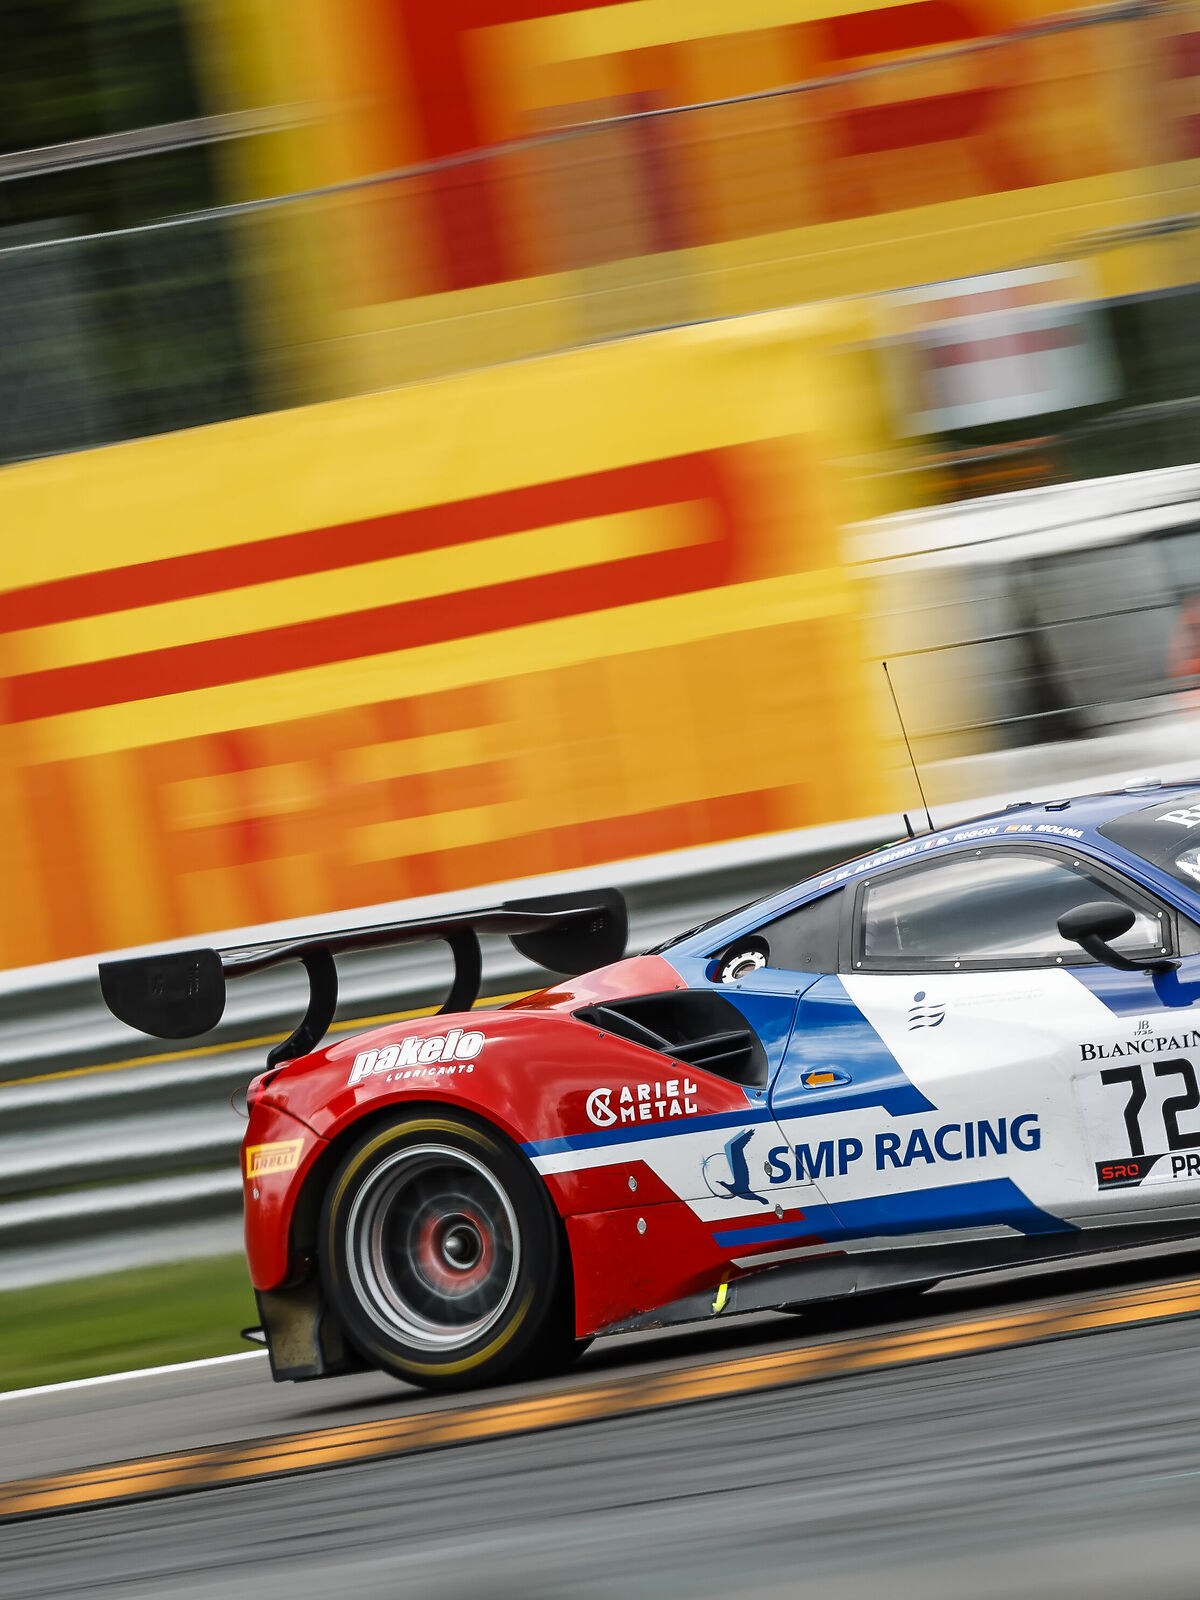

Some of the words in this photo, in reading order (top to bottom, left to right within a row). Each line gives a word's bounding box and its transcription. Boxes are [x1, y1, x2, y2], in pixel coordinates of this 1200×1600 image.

[953, 827, 999, 841] RIGON
[1035, 825, 1085, 839] MOLINA
[347, 1029, 486, 1086] pakelo
[385, 1064, 475, 1083] LUBRICANTS
[619, 1078, 697, 1104] ARIEL
[620, 1097, 698, 1123] METAL
[250, 1146, 297, 1172] PIRELLI
[767, 1136, 864, 1184] SMP
[874, 1113, 1042, 1171] RACING
[1101, 1163, 1140, 1180] SRO
